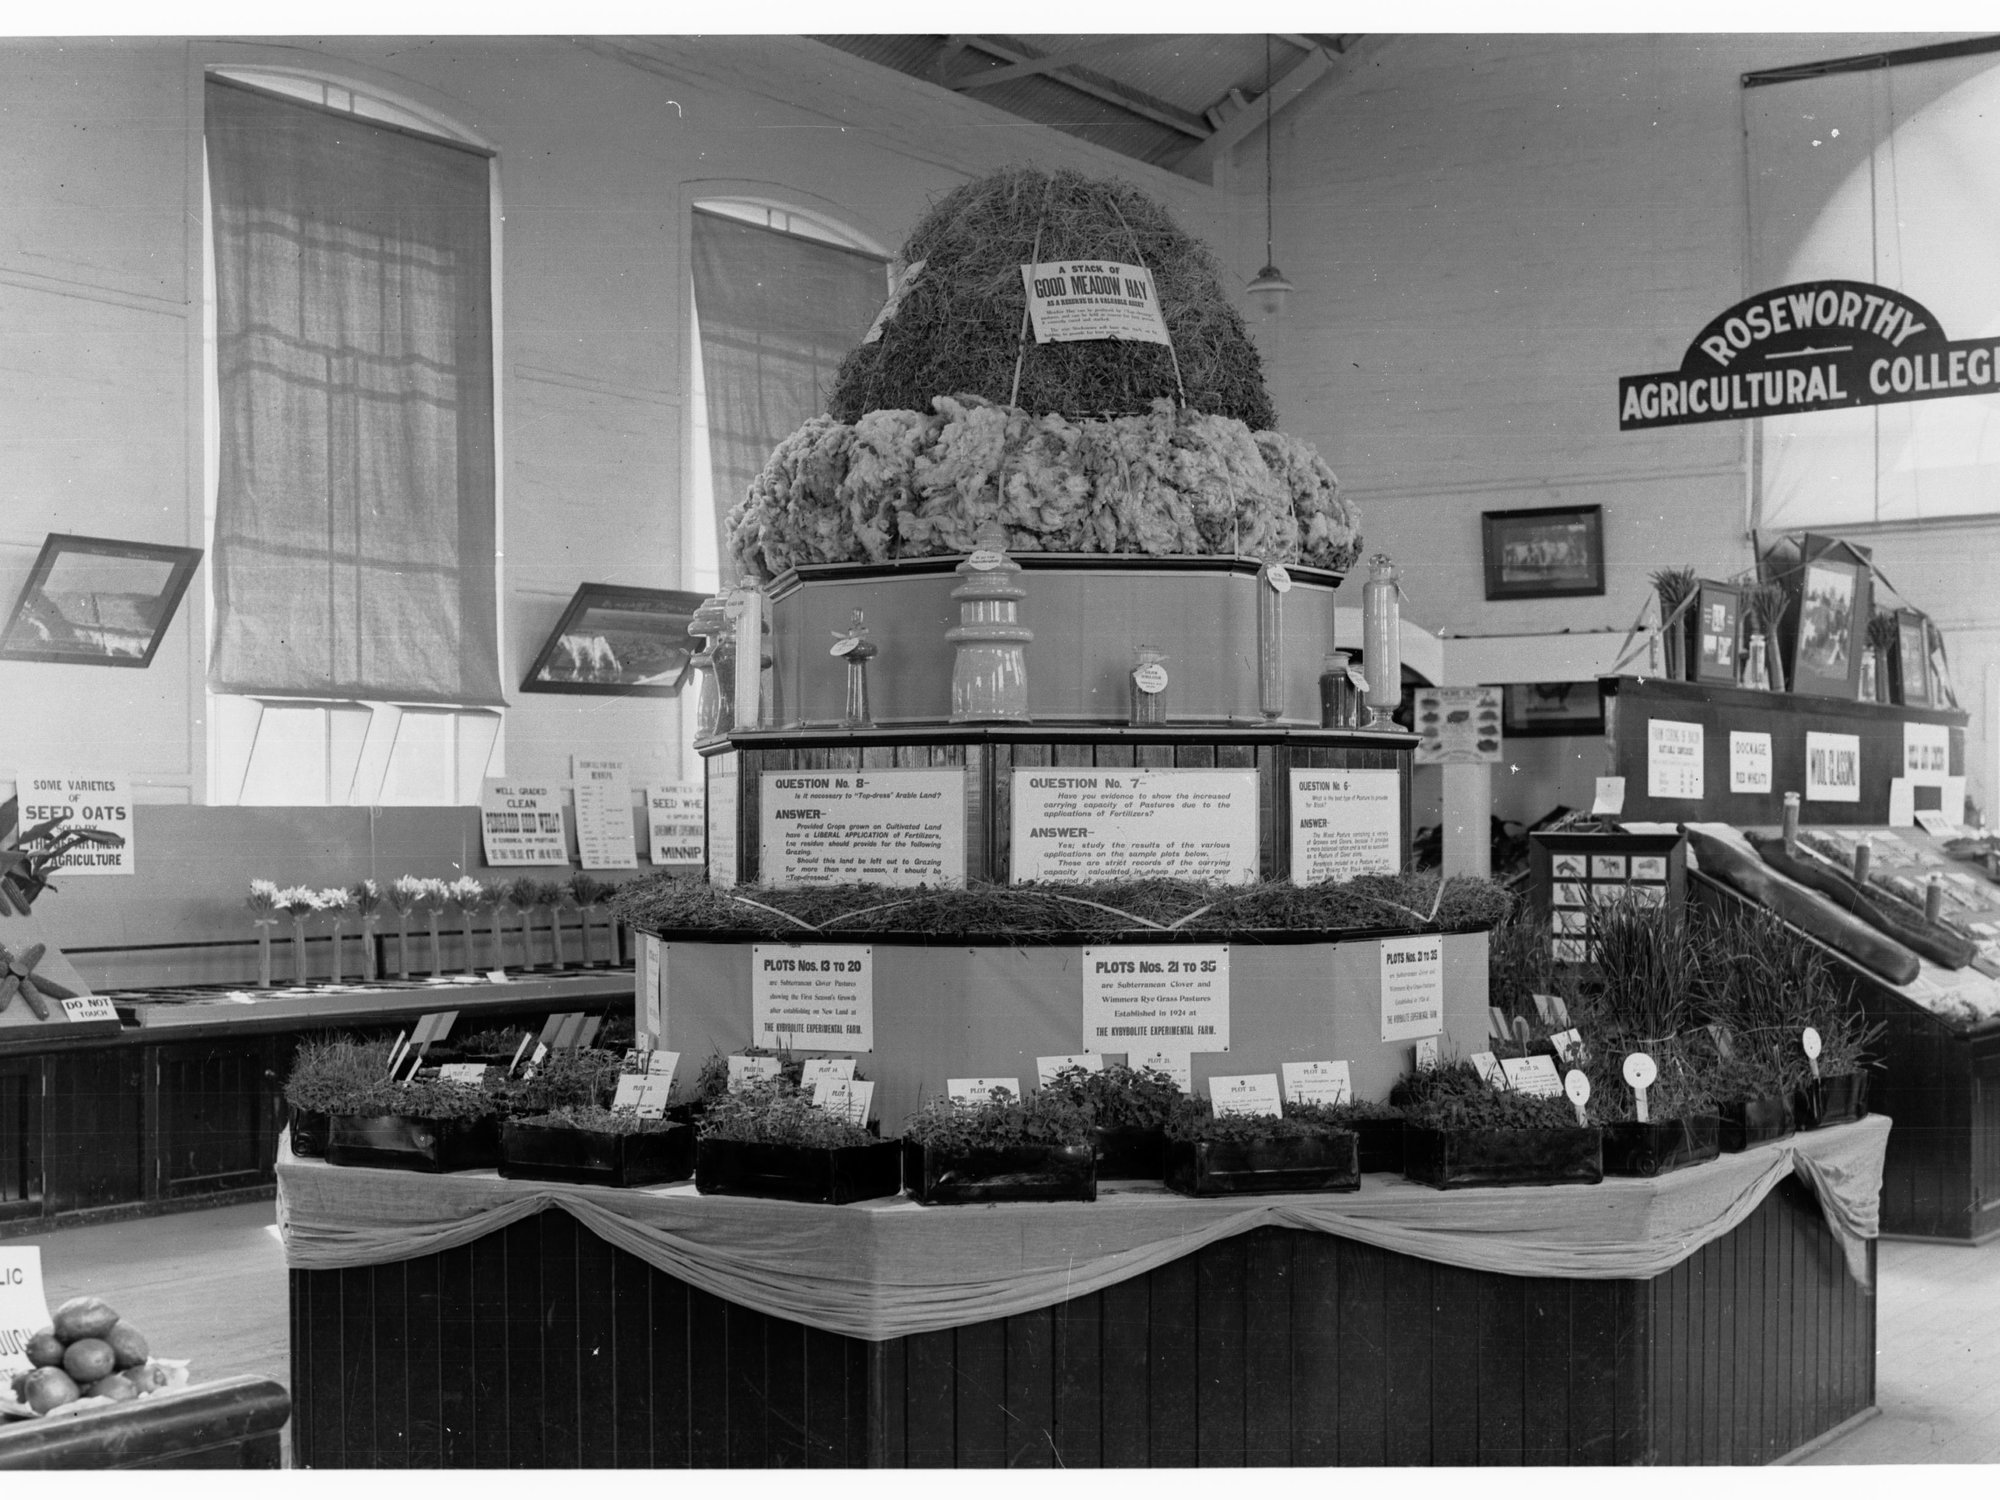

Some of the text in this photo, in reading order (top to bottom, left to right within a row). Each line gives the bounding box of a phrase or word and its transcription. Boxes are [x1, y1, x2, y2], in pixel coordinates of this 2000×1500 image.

[1059, 264, 1120, 274] A STACK OF
[1034, 276, 1148, 300] GOOD MEADOW HAY
[1700, 290, 1926, 366] ROSEWORTHY
[1622, 365, 1848, 422] AGRICULTURAL
[33, 780, 116, 791] SOME VARIETIES
[775, 778, 829, 789] QUESTION
[835, 778, 849, 788] No.
[1030, 778, 1097, 788] QUESTION
[1105, 778, 1121, 788] No.
[1299, 781, 1330, 791] QUESTION
[68, 794, 81, 802] OF
[507, 800, 536, 808] CLEAN
[652, 799, 677, 808] SEED
[1044, 802, 1077, 810] carrying
[1084, 802, 1117, 810] capacity
[26, 805, 126, 820] SEED OATS
[904, 832, 941, 840] Fertilizers,
[853, 840, 877, 848] provide
[911, 841, 941, 849] following
[1082, 842, 1104, 850] study
[662, 847, 701, 859] MINNIP
[1044, 850, 1091, 859] applications
[1129, 850, 1156, 858] sample
[51, 854, 122, 866] AGRICULTURE
[914, 858, 941, 867] Grazing
[1387, 953, 1404, 965] PLOTS
[1430, 949, 1437, 960] 35
[764, 960, 861, 972] PLOTS Nos. 13 TO 20
[1096, 961, 1217, 973] PLOTS Nos. 21 TO 35
[65, 998, 110, 1010] DO NOT
[1141, 996, 1154, 1004] Rye
[80, 1010, 108, 1018] TOUCH
[764, 1023, 862, 1034] THE KYBYBOLITE EXPERIMENTAL FARM.
[1096, 1025, 1216, 1036] THE KYBYBOLITE EXPERIMENTAL FARM.
